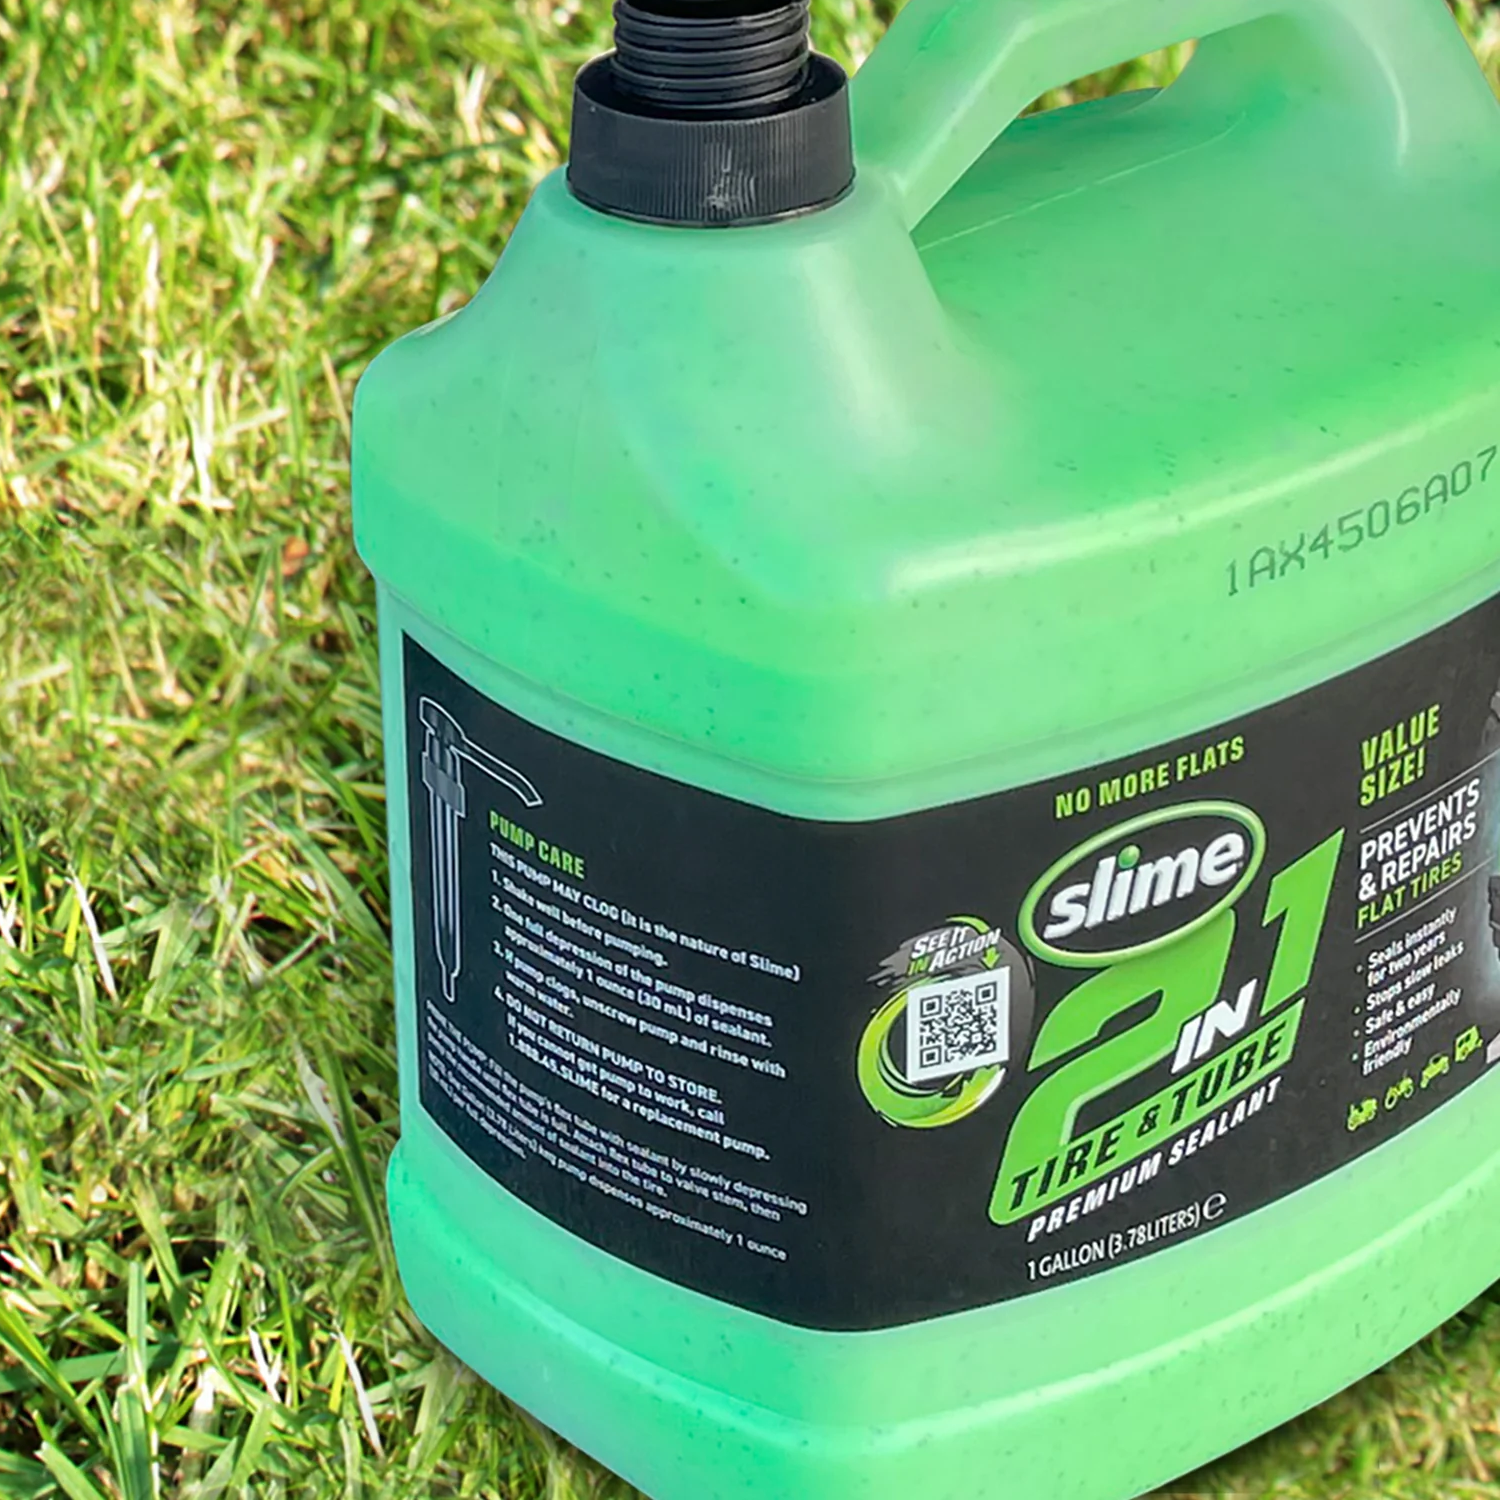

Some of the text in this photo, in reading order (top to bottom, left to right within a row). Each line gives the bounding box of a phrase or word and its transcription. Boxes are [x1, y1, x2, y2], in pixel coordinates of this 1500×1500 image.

[1226, 444, 1498, 596] 1AX4506A07
[1362, 704, 1440, 771] VALUE
[1055, 736, 1245, 819] NO MORE FLATS
[1359, 747, 1426, 807] SIZE!
[489, 810, 585, 879] PUMP CARE
[1358, 811, 1477, 902] & REPAIRS
[1360, 777, 1480, 870] PREVENTS
[490, 842, 515, 869] THIS
[517, 859, 551, 886] PUMP
[553, 880, 581, 903] MAY
[583, 895, 619, 920] CLOG
[639, 917, 651, 933] is
[654, 924, 677, 942] the
[680, 934, 728, 960] nature
[731, 951, 747, 966] of
[750, 954, 800, 981] Slime)
[503, 877, 534, 906] Shake
[536, 900, 561, 920] well
[562, 910, 601, 939] before
[604, 933, 668, 967] pumping.
[1043, 833, 1245, 940] slime
[1357, 851, 1463, 929] FLAT TIRES
[908, 927, 1001, 976] IN ACTION
[911, 926, 971, 959] SEE IT
[1171, 978, 1257, 1074] IN
[1262, 828, 1345, 1017] 1
[1367, 931, 1446, 987] for two years
[1368, 906, 1457, 969] Seals instantly
[546, 931, 613, 971] depression
[615, 964, 629, 977] of
[630, 968, 652, 987] the
[655, 979, 695, 1004] pump
[698, 993, 773, 1027] dispenses
[596, 976, 635, 1000] ounce
[637, 988, 662, 1011] (30
[663, 1002, 692, 1022] mL)
[694, 1013, 709, 1027] of
[711, 1019, 772, 1048] sealant.
[1364, 983, 1436, 1034] Safe & easy
[1366, 941, 1464, 1011] Stops slow leaks
[506, 992, 522, 1013] DO
[523, 1004, 548, 1027] NOT
[548, 1019, 600, 1057] RETURN
[601, 1046, 643, 1074] PUMP
[645, 1064, 665, 1083] TO
[667, 1074, 723, 1104] STORE.
[514, 957, 544, 983] pump
[546, 976, 580, 1004] clogs,
[582, 995, 637, 1027] unscrew
[639, 1020, 678, 1045] pump
[681, 1034, 707, 1054] and
[710, 1044, 748, 1066] rinse
[751, 1056, 786, 1078] with
[1363, 988, 1462, 1058] Environmentally
[537, 1035, 576, 1064] cannot
[577, 1057, 598, 1074] get
[600, 1067, 636, 1093] pump
[638, 1083, 652, 1099] to
[654, 1091, 695, 1117] work,
[698, 1107, 725, 1125] call
[1362, 1036, 1413, 1077] friendly
[601, 1085, 620, 1104] for
[622, 1098, 631, 1110] a
[633, 1101, 721, 1144] replacement
[723, 1135, 771, 1161] pump.
[1009, 1020, 1286, 1212] TIRE & TUBE
[599, 1128, 625, 1148] with
[626, 1141, 669, 1166] sealant
[671, 1158, 688, 1175] by
[689, 1167, 732, 1190] slowly
[733, 1181, 807, 1216] depressing
[621, 1169, 641, 1186] the
[642, 1178, 668, 1198] tire.
[631, 1158, 658, 1178] tube
[660, 1170, 673, 1184] to
[675, 1177, 709, 1198] valve
[750, 1202, 781, 1222] then
[1027, 1076, 1282, 1243] PREMIUM SEALANT
[645, 1202, 733, 1245] approximately
[736, 1233, 744, 1247] 1
[747, 1239, 787, 1261] ounce
[1027, 1260, 1036, 1280] 1
[1039, 1239, 1105, 1276] GALLON
